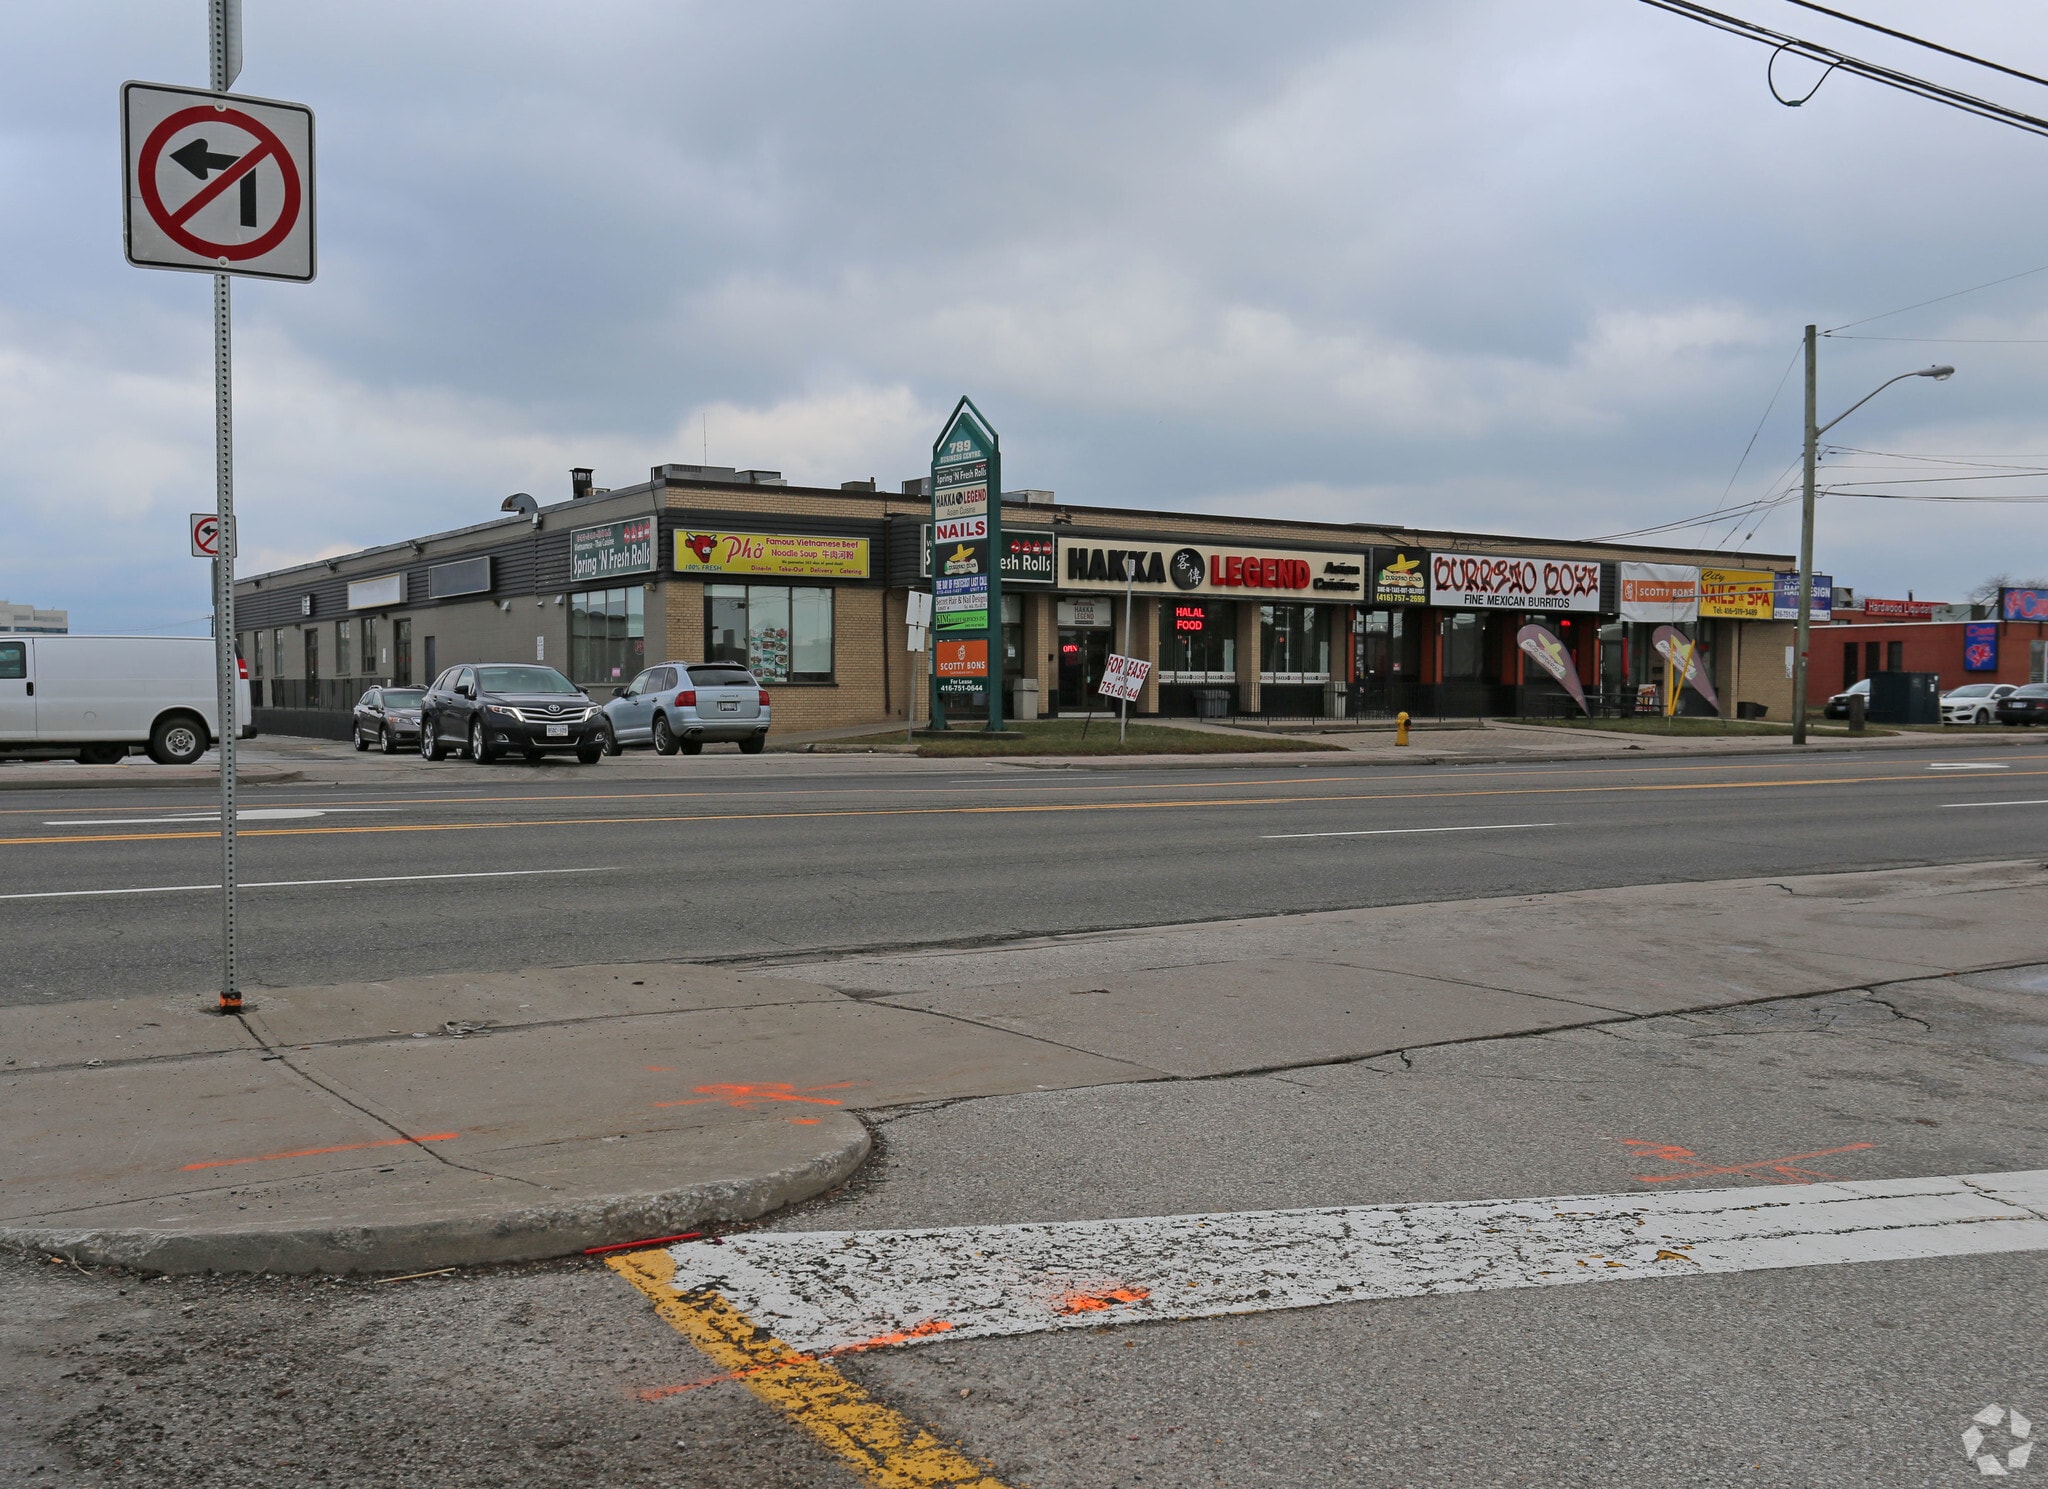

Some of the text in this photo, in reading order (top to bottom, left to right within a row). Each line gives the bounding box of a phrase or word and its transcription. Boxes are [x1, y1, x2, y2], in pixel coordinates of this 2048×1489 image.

[950, 441, 971, 454] 789
[940, 450, 981, 463] BUSINESS CENTRE
[936, 475, 953, 485] Spring
[960, 469, 974, 480] Fresh
[975, 467, 987, 478] Rolls
[936, 488, 986, 508] HAKKA LEGEND
[936, 521, 985, 540] NAILS
[765, 537, 858, 549] Famous Vietnamese Beef
[771, 548, 818, 559] Noodle Soup
[821, 549, 854, 560] 牛肉河粉
[573, 541, 650, 579] Spring 'N Fresh Rolls
[1000, 554, 1051, 572] esh Rolls
[778, 565, 804, 573] Take-Out
[810, 566, 833, 574] Delivery
[840, 567, 862, 576] Catering
[1067, 547, 1167, 583] HAKKA
[1210, 554, 1311, 589] LEGEND
[1434, 556, 1599, 598] BURRITO BOYZ
[1701, 571, 1725, 582] City
[1376, 593, 1393, 602] (416)
[1639, 587, 1694, 597] SCOTTY BONS
[1700, 583, 1736, 605] NAILS
[1738, 591, 1745, 602] &
[1747, 586, 1770, 606] SPA
[1810, 586, 1831, 598] ESIGN
[949, 596, 958, 604] Hair
[958, 595, 963, 603] &
[963, 594, 971, 604] Nail
[1464, 594, 1570, 608] FINE MEXICAN BURRITOS
[1175, 607, 1204, 617] HALAL
[1713, 606, 1723, 614] Tel:
[1868, 601, 1902, 612] Hardwood
[1074, 612, 1095, 620] LEGEND
[1176, 620, 1202, 630] FOOD
[1062, 645, 1079, 653] OPEN
[940, 661, 986, 671] SCOTTY BONS
[1105, 656, 1124, 674] FOR
[1100, 681, 1139, 699] 751-044
